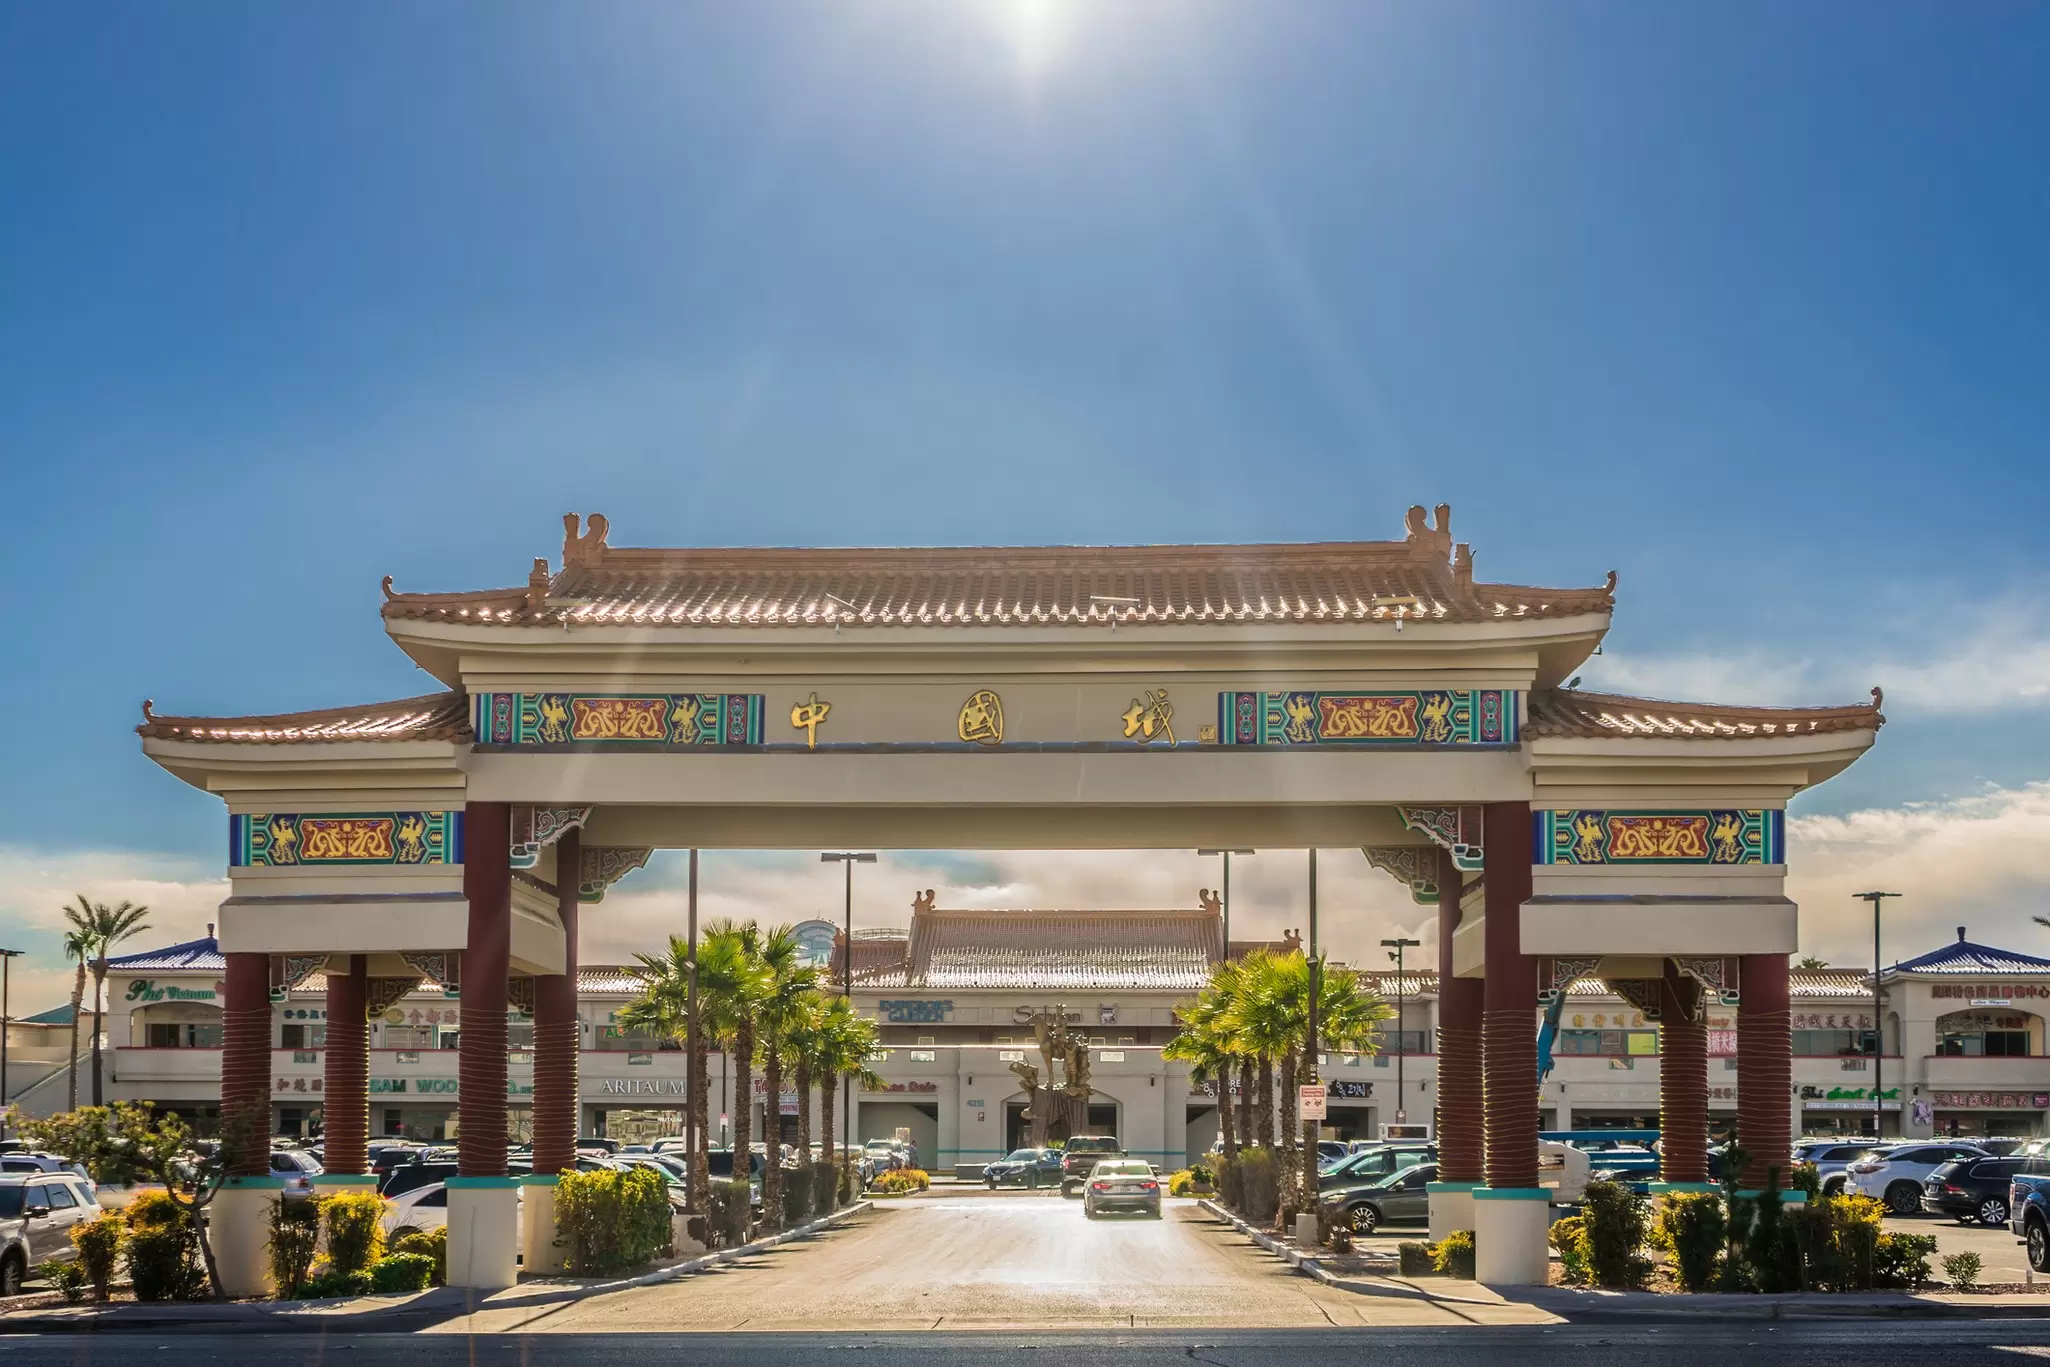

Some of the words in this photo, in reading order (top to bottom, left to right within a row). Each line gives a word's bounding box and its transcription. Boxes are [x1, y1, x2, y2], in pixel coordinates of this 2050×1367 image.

[166, 986, 216, 999] Vietnam
[369, 1079, 406, 1093] SAM
[416, 1079, 457, 1093] WOO
[601, 1080, 685, 1094] ARITAUM
